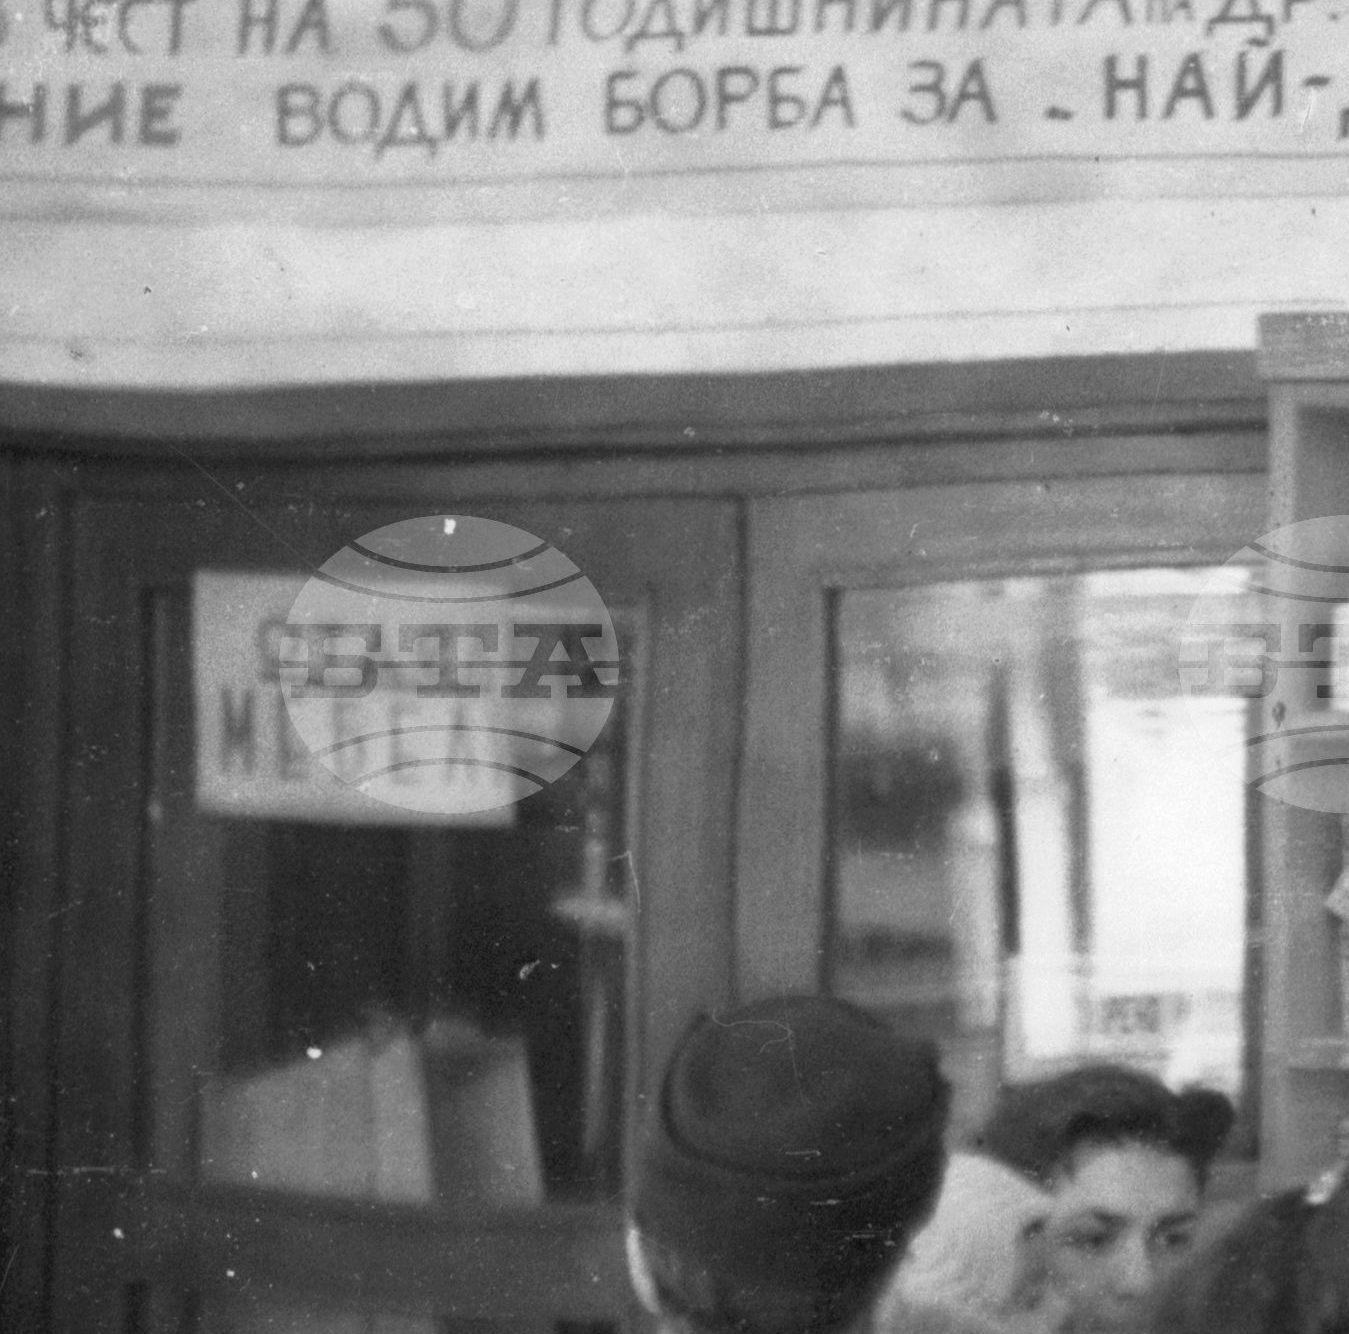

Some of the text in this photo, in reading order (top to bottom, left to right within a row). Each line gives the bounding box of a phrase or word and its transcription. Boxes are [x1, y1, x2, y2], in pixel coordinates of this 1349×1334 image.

[274, 78, 546, 157] ВОДИМ
[603, 65, 858, 137] БОРБА
[900, 56, 998, 127] ЗА
